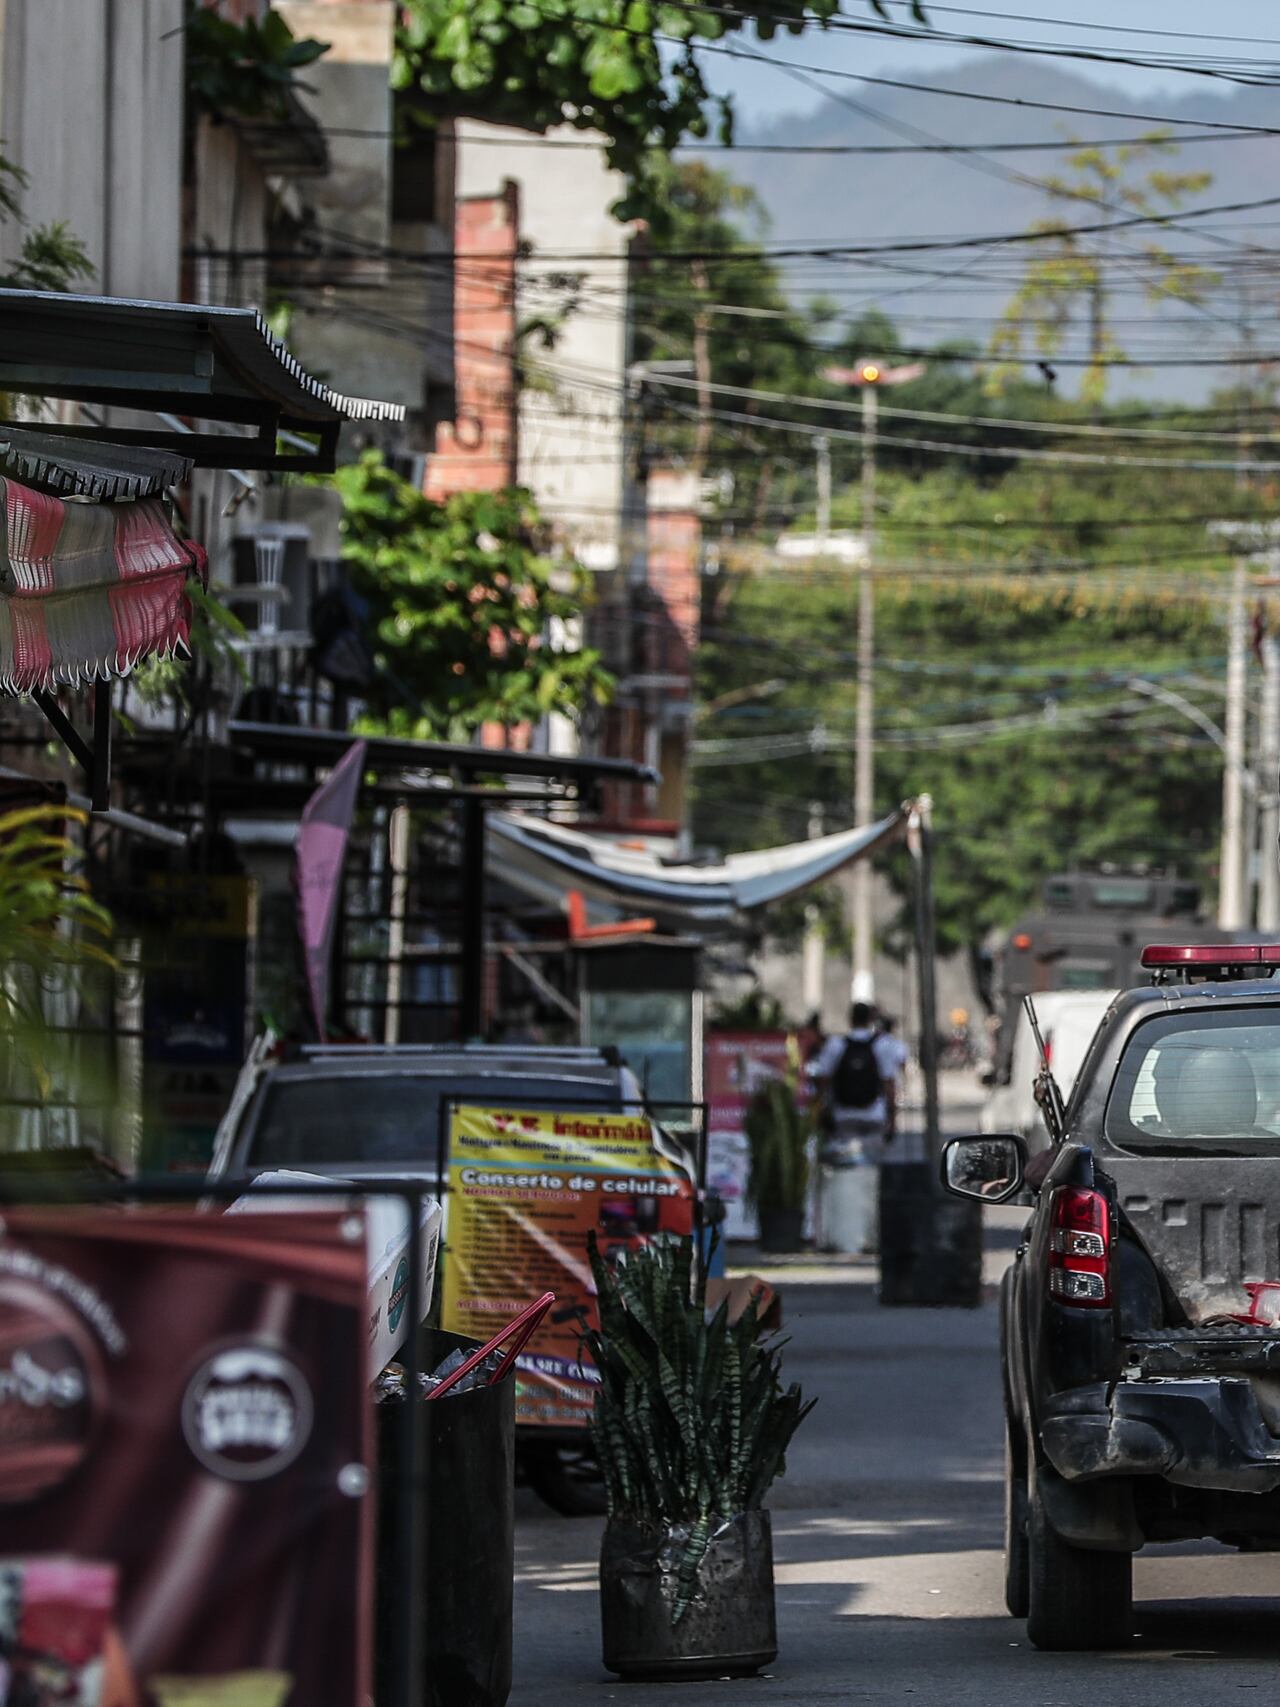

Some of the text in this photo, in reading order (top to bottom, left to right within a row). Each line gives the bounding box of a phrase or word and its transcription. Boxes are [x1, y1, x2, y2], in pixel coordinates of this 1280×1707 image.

[461, 1168, 681, 1196] Conserto de celular
